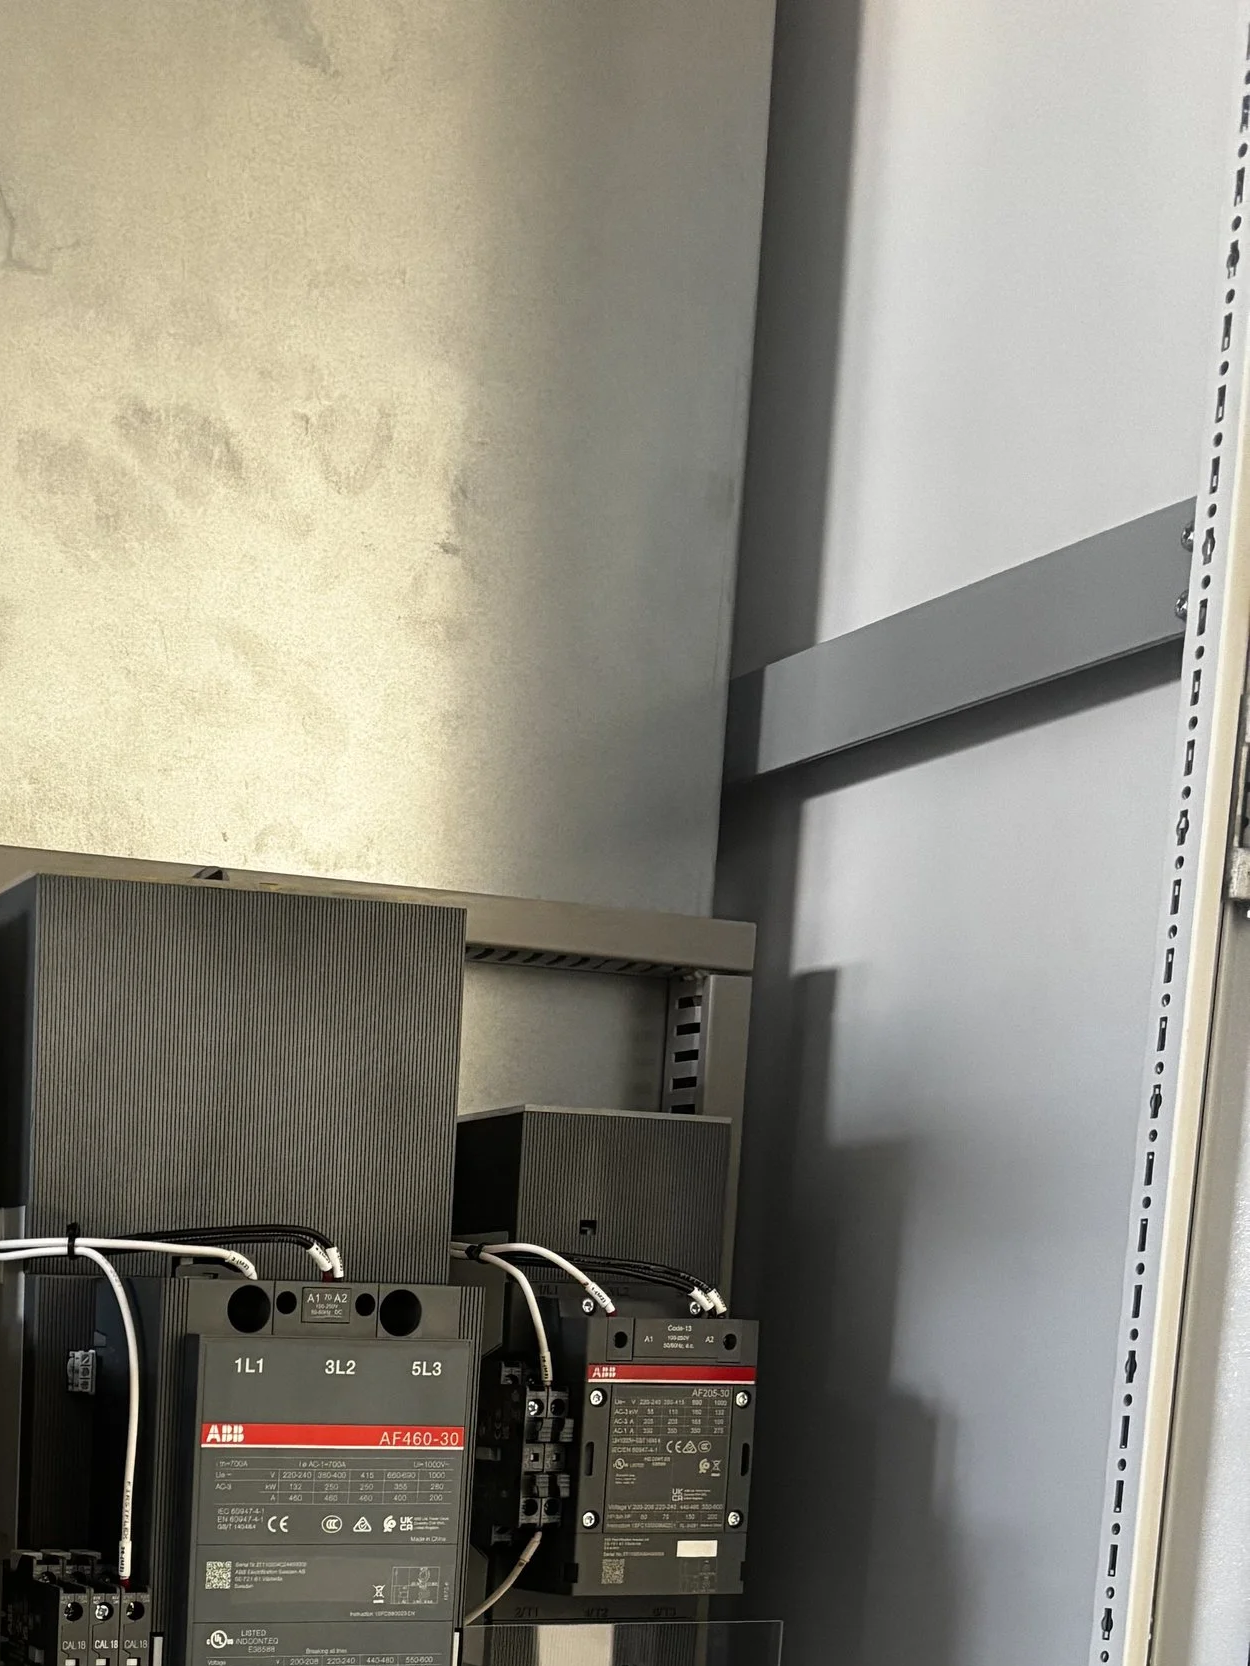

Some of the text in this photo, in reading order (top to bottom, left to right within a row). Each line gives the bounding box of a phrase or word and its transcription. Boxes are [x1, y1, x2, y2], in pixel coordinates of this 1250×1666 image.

[306, 1293, 320, 1303] A1
[334, 1293, 348, 1303] A2
[644, 1335, 654, 1343] A1
[705, 1335, 715, 1343] A2
[234, 1358, 264, 1373] 1L1
[325, 1360, 356, 1375] 3L2
[412, 1362, 441, 1376] 5L3
[592, 1367, 616, 1378] ABB
[692, 1389, 730, 1397] AF205-30
[206, 1425, 245, 1442] ABB
[379, 1431, 459, 1446] AF460-30
[317, 1472, 347, 1480] 380-400
[267, 1516, 289, 1532] CE
[62, 1640, 86, 1650] CAL 18
[95, 1640, 118, 1649] CAL 18
[124, 1640, 147, 1649] CAL 18
